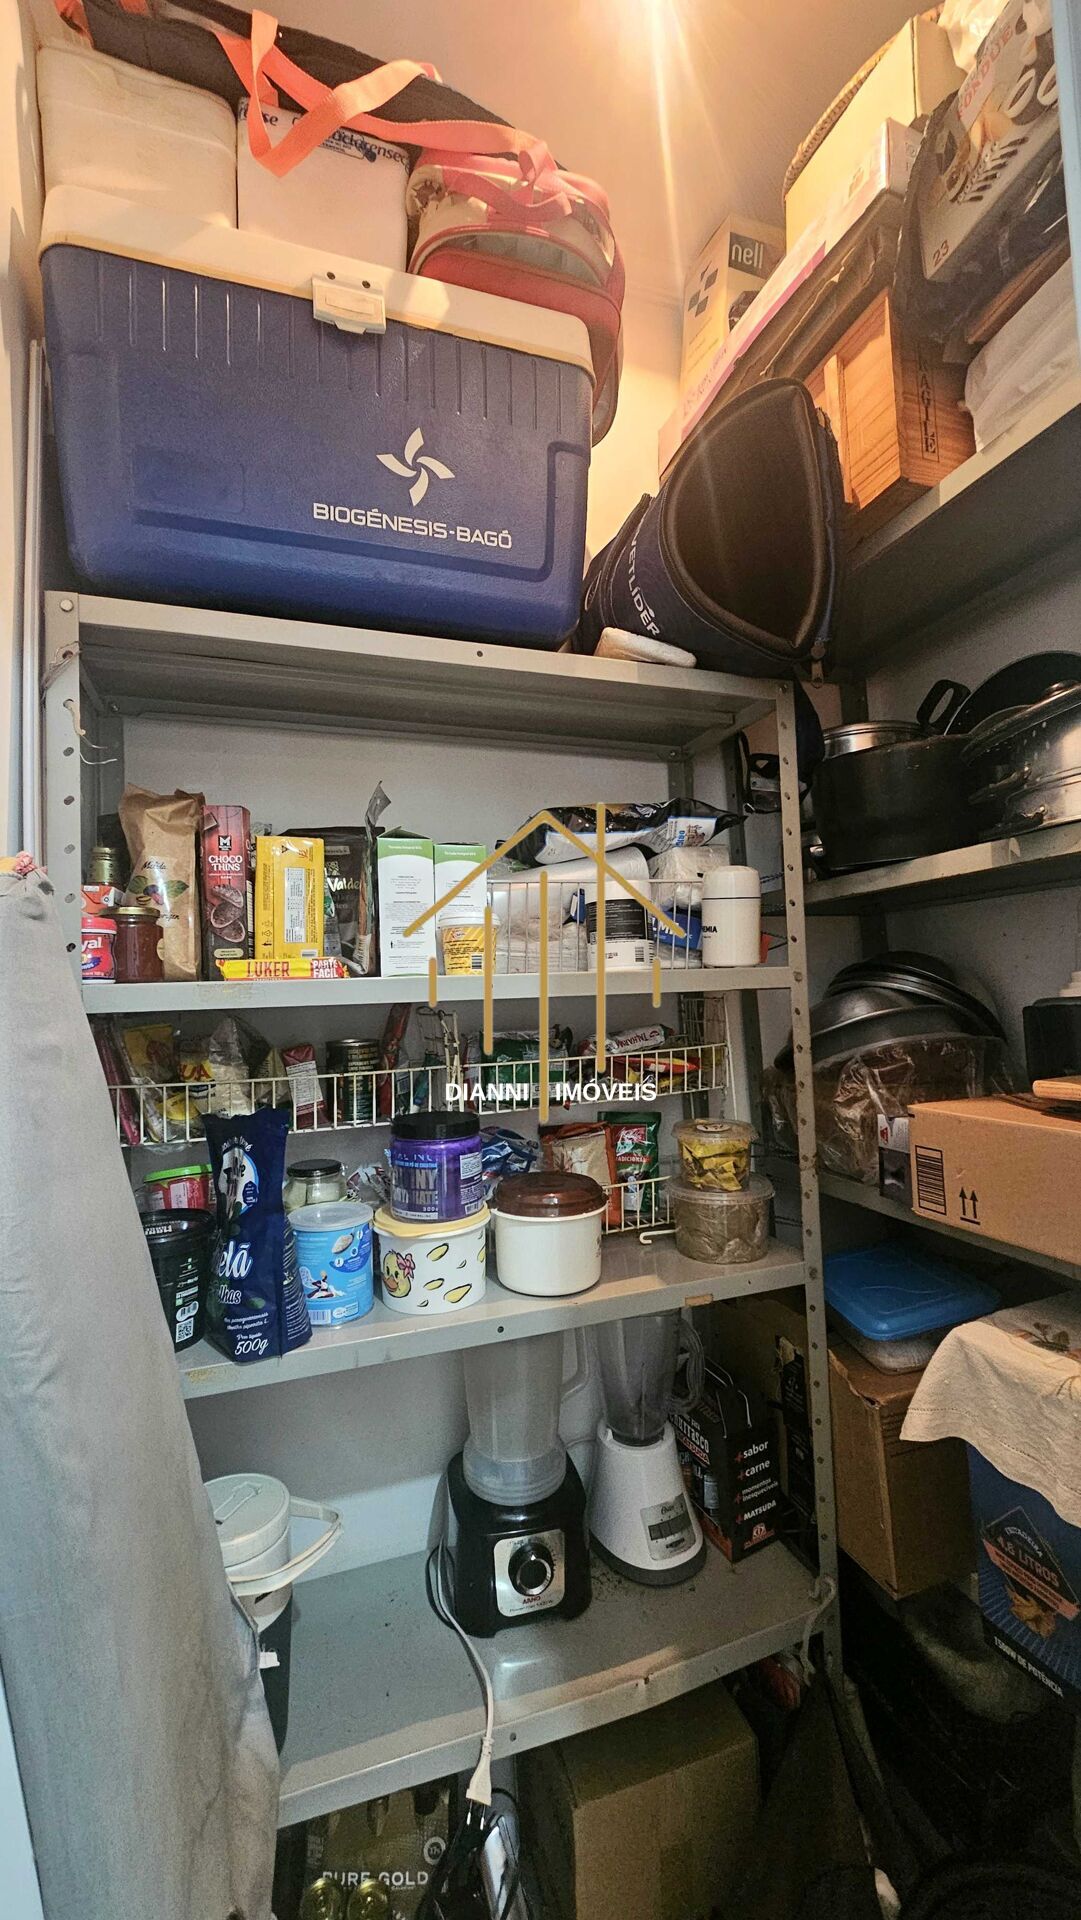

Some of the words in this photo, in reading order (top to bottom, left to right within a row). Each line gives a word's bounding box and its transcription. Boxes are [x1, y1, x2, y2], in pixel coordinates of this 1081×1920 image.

[730, 240, 764, 269] nell
[313, 502, 512, 549] BIOGÉNESIS-BAGÓ
[208, 855, 243, 864] CHOCO
[211, 863, 240, 872] THINS
[326, 877, 360, 892] Valde
[81, 936, 103, 954] yal
[246, 961, 289, 978] LUKER
[219, 1240, 252, 1279] elã
[217, 1285, 241, 1305] lhas
[234, 1338, 269, 1357] 500g
[378, 1870, 429, 1886] GOLD
